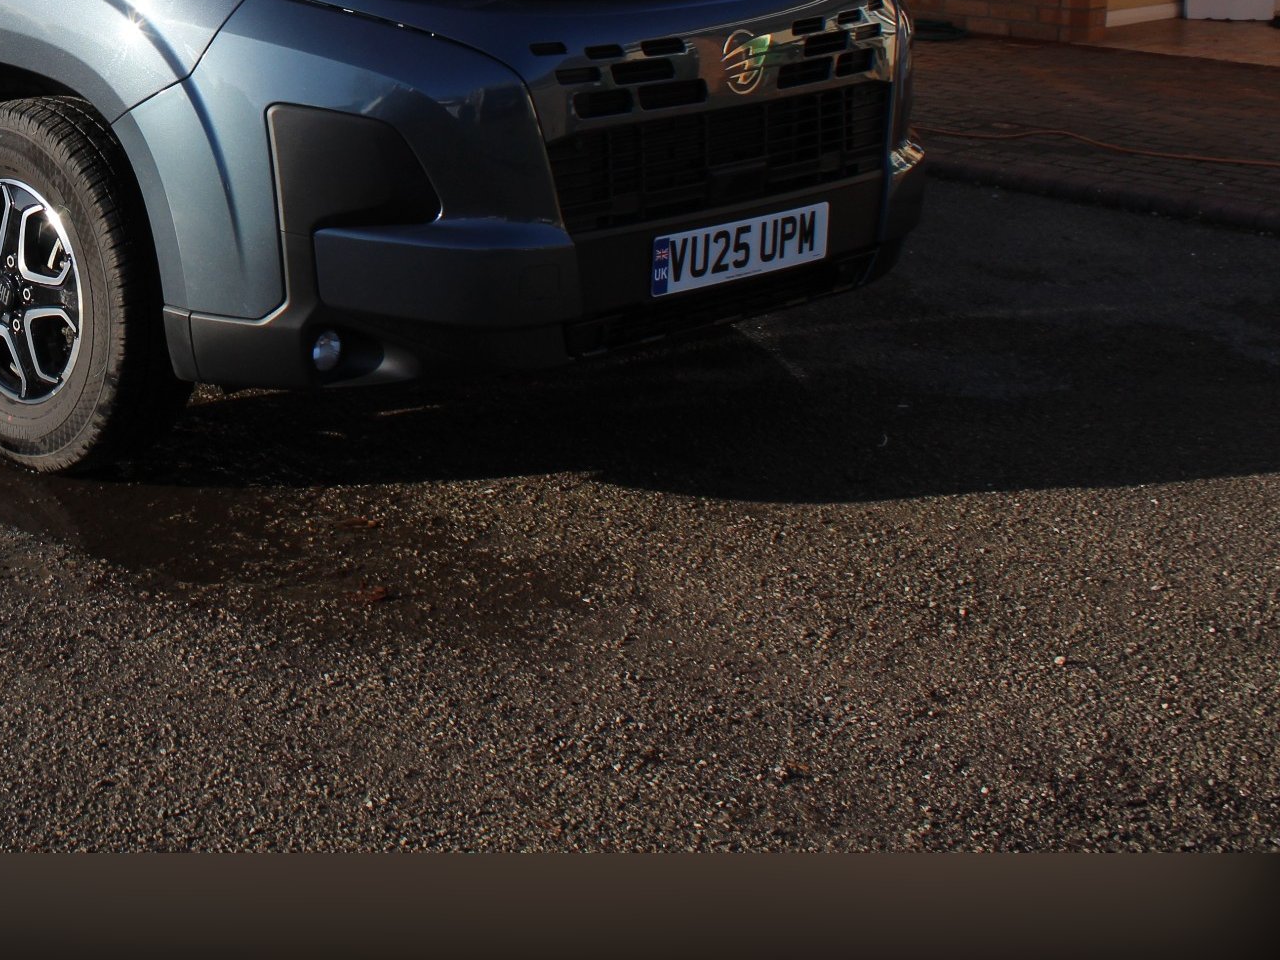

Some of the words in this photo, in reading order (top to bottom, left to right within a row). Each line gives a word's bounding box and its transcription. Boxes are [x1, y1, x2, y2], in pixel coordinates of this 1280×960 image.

[669, 224, 752, 283] VU25
[759, 210, 817, 263] UPM
[654, 266, 668, 281] UK
